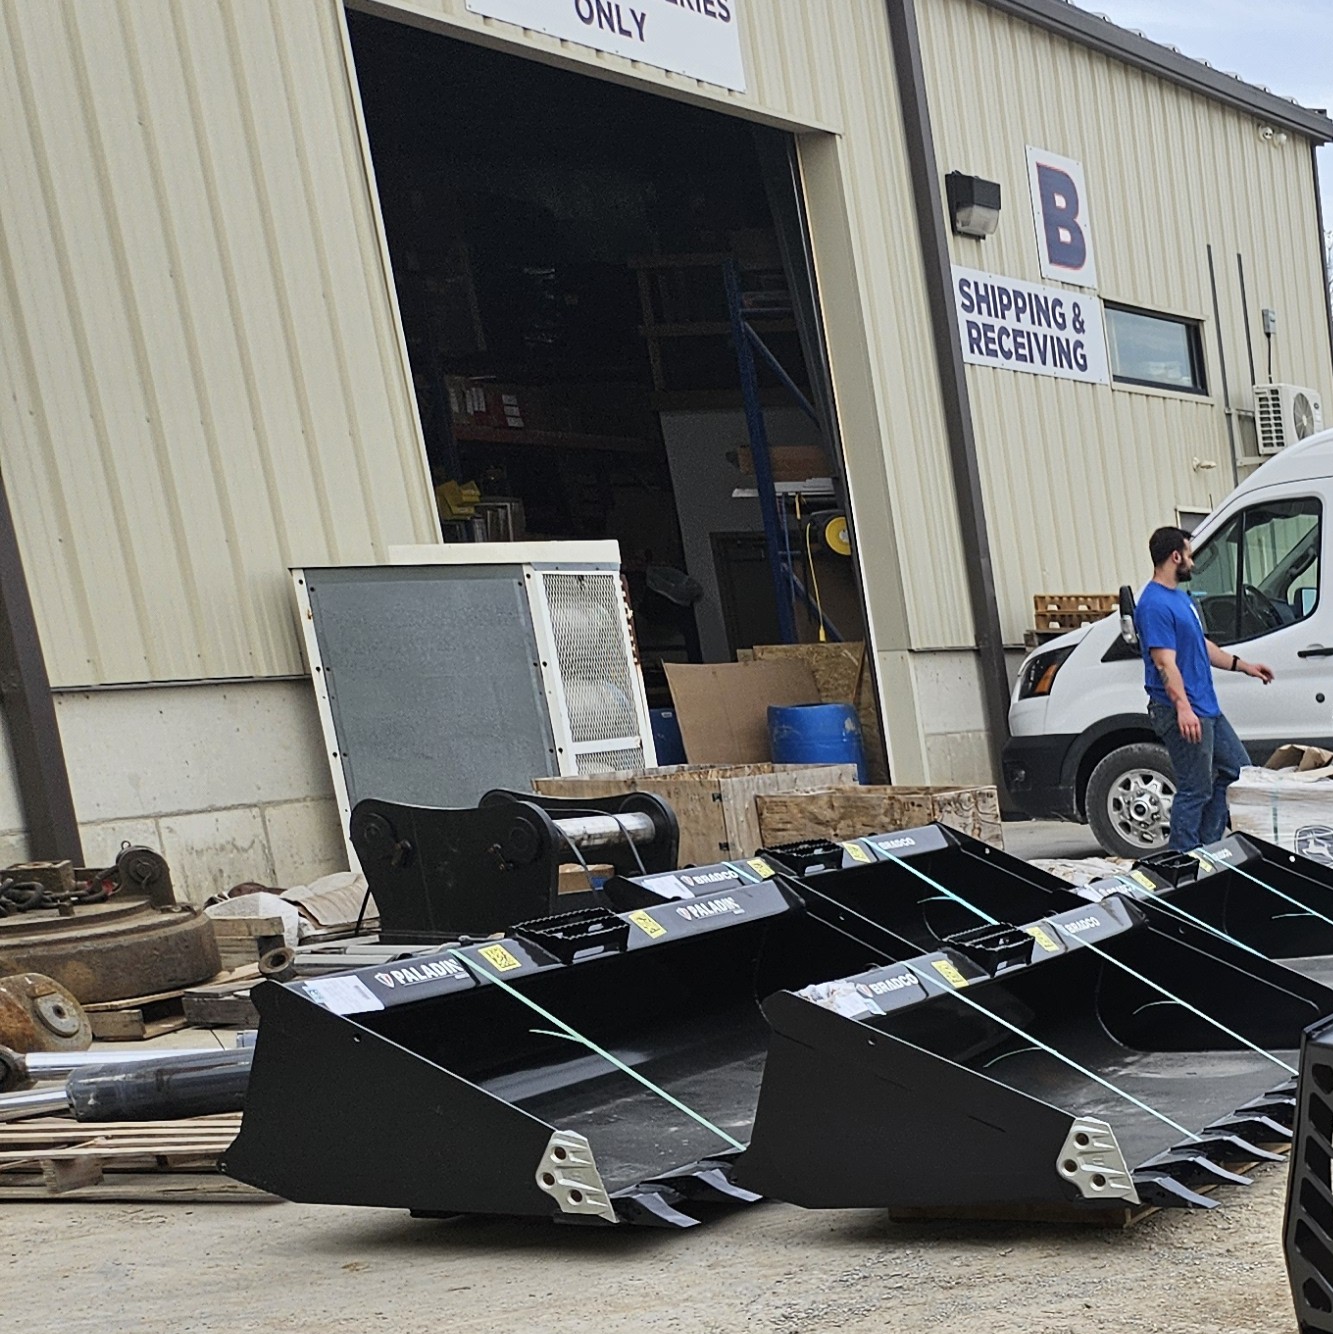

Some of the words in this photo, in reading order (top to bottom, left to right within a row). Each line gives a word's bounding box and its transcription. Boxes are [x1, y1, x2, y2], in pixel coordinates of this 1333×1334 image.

[574, 0, 646, 42] ONLY
[1036, 161, 1087, 270] B
[958, 277, 1067, 331] SHIPPING
[1072, 301, 1086, 335] &
[966, 320, 1088, 372] RECEIVING
[694, 869, 739, 885] BRADCO
[687, 897, 740, 918] PALADIN
[391, 958, 464, 985] PALADIN
[868, 973, 920, 995] BRADCO
